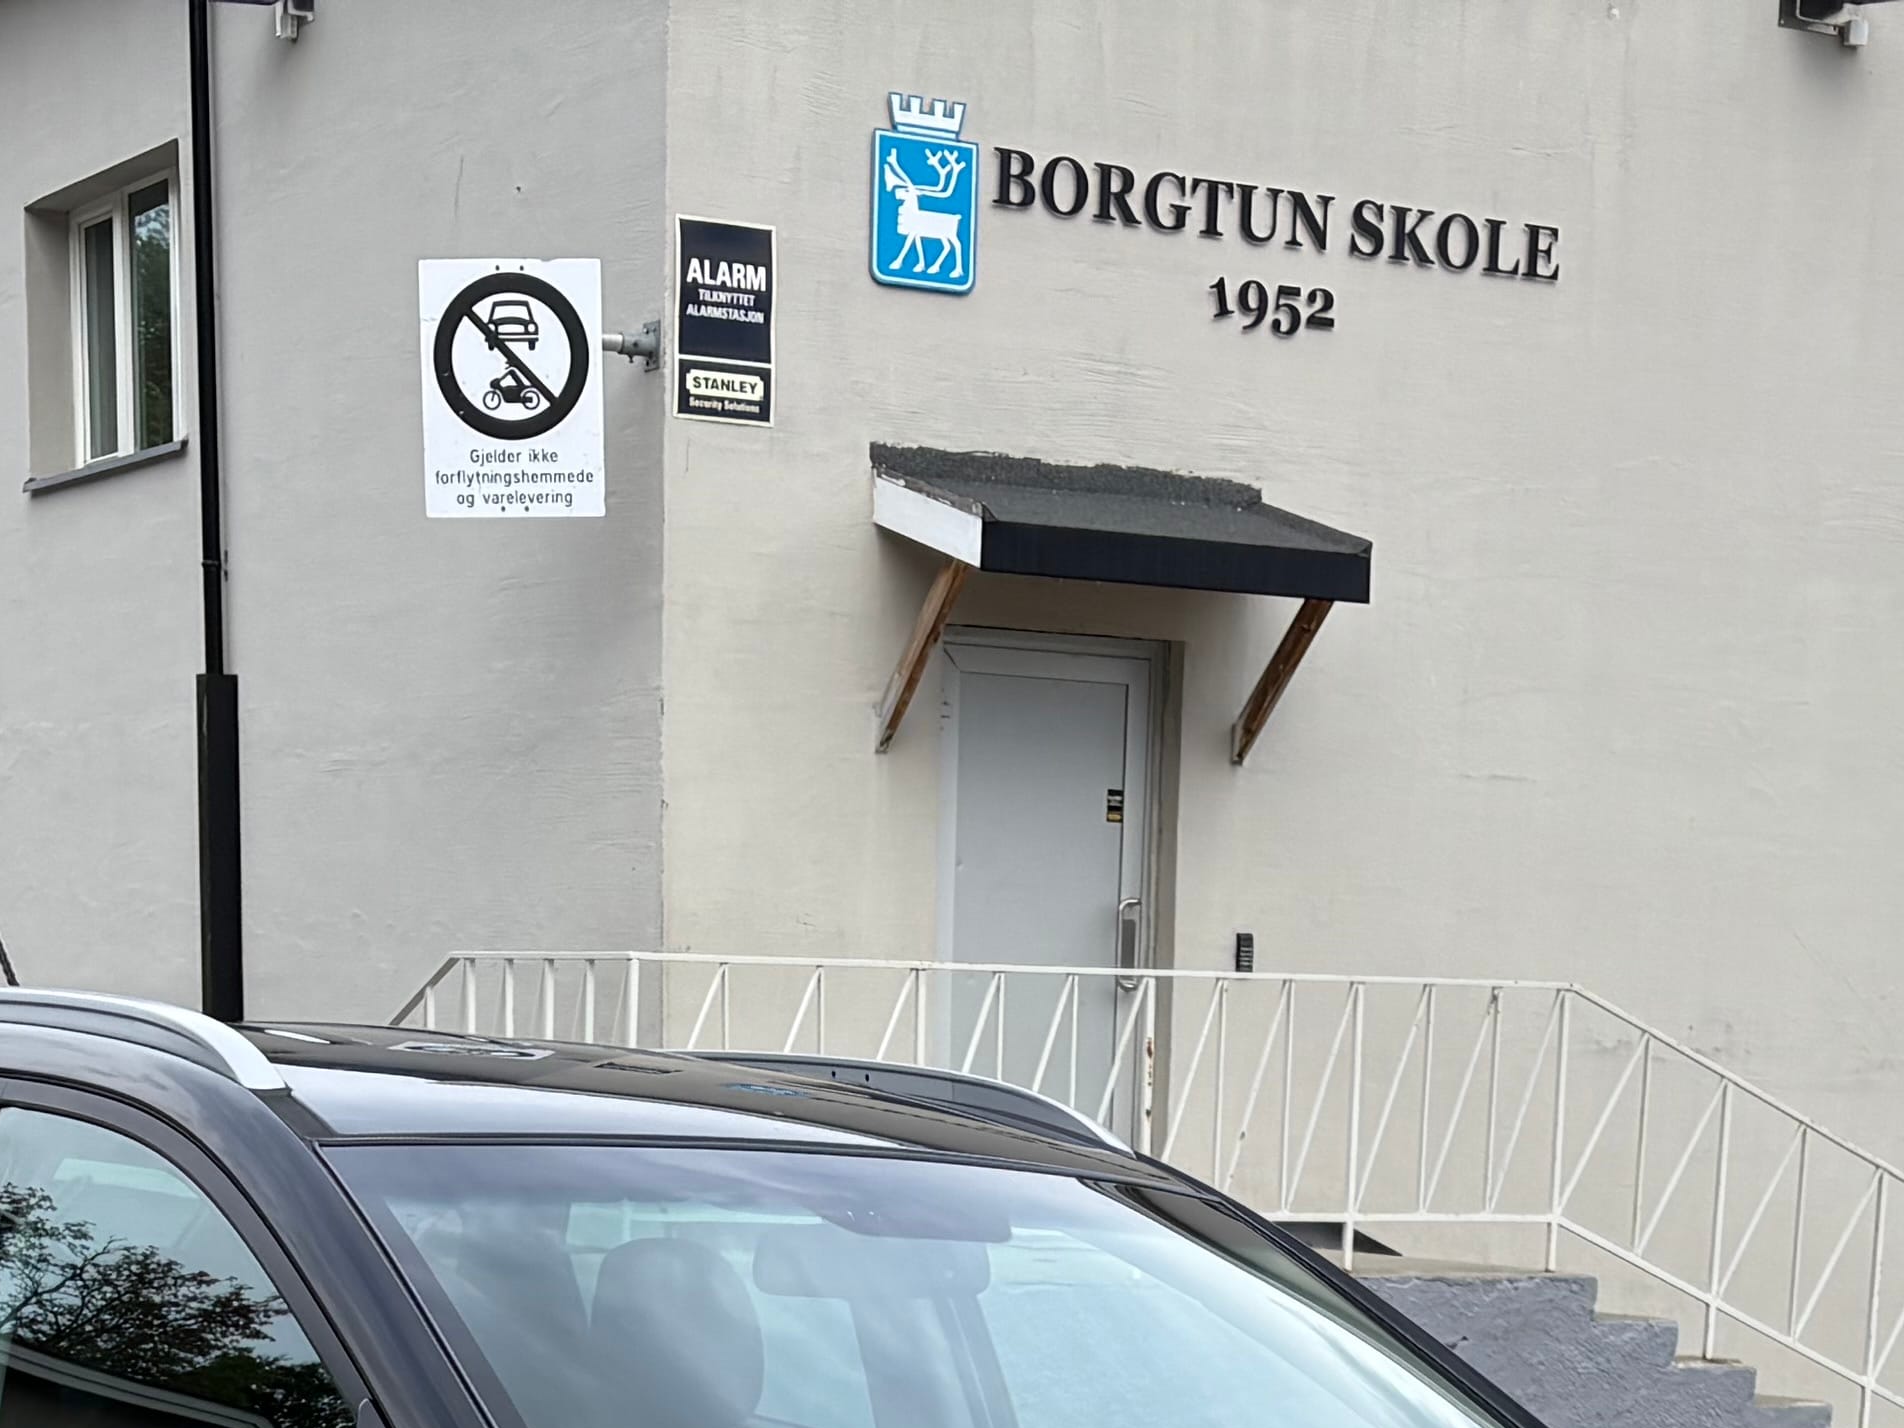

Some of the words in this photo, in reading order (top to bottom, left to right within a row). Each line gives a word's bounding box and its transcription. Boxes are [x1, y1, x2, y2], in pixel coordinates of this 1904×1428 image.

[992, 146, 1336, 252] BORGTUN
[1349, 199, 1560, 282] SKOLE
[686, 257, 766, 292] ALARM
[698, 288, 755, 307] TILKNYTTET
[1209, 277, 1335, 337] 1952
[686, 303, 764, 324] ALARMSTASJON
[692, 376, 758, 395] STANLEY
[469, 449, 522, 467] Gjelder
[528, 449, 559, 463] ikke
[435, 469, 594, 488] forflytningshemmede
[456, 493, 475, 508] og
[483, 490, 573, 508] varelevering
